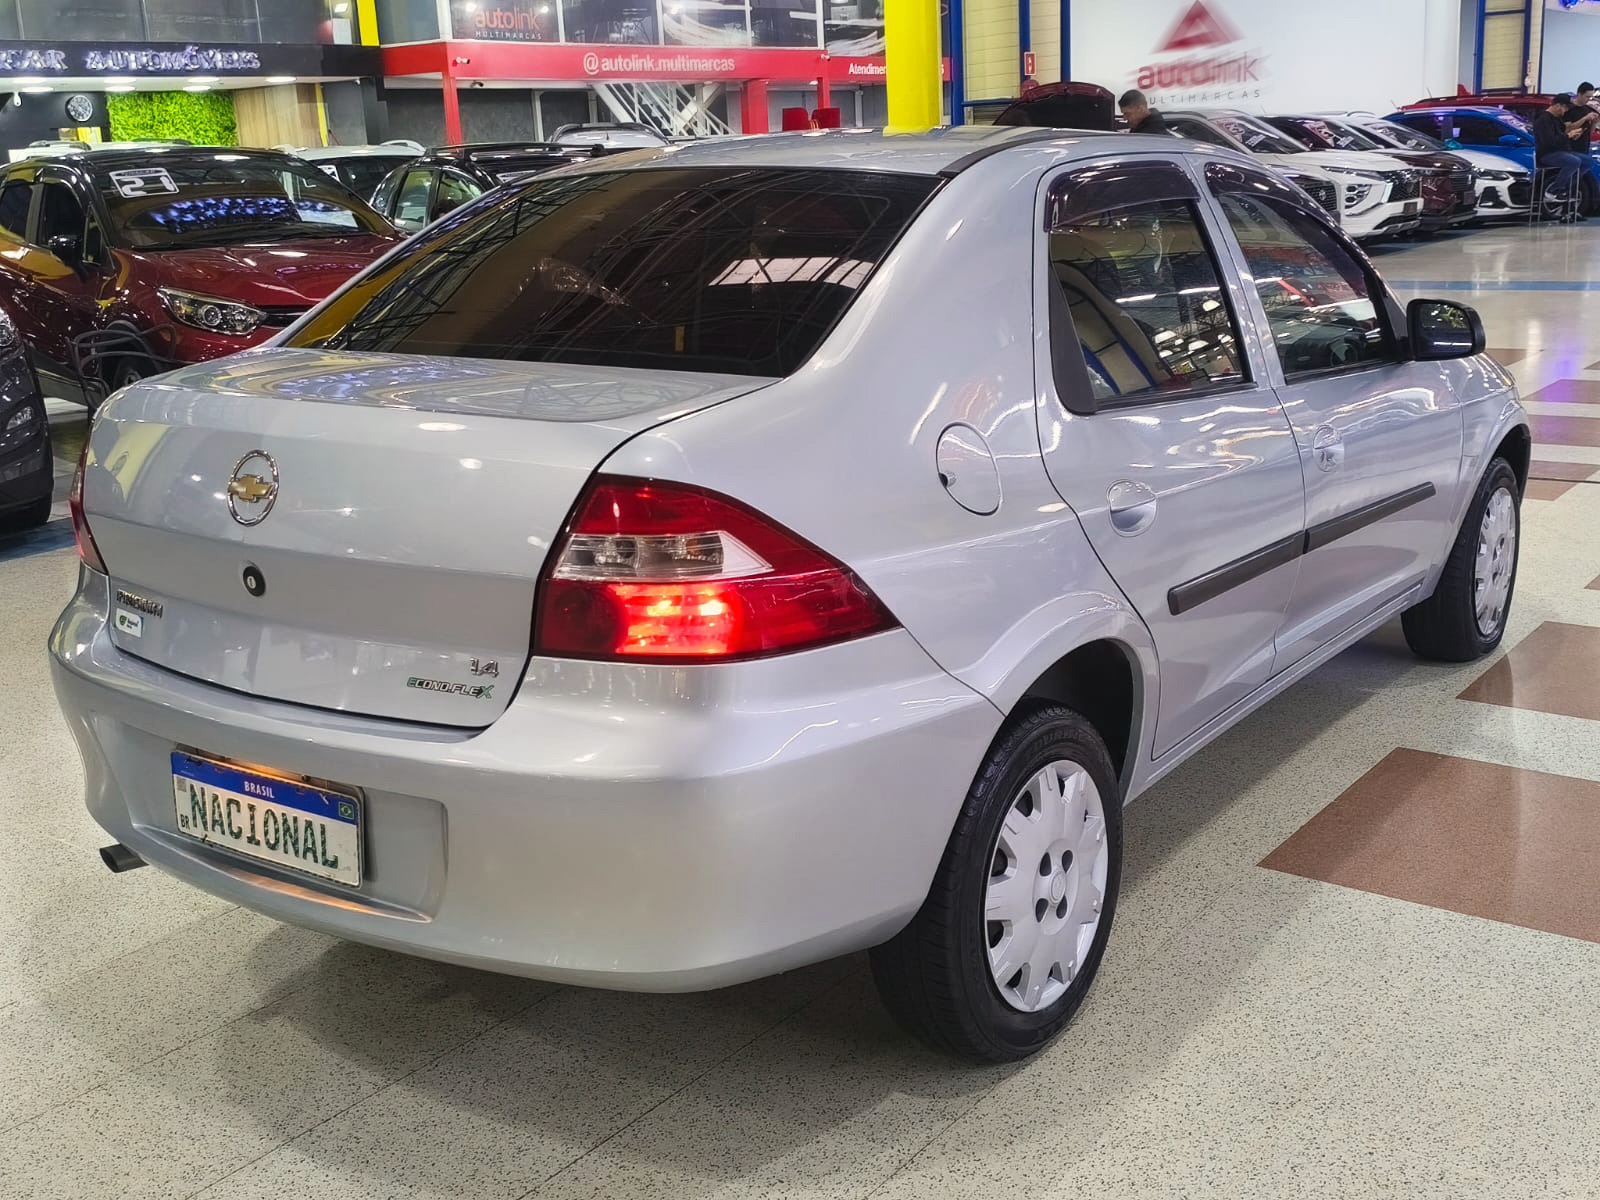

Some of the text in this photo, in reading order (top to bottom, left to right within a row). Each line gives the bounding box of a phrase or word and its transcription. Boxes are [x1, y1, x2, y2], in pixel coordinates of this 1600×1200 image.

[475, 7, 540, 30] autolink
[475, 31, 542, 40] MULTIMARCAS
[1149, 89, 1261, 105] ULTIMARCAS
[243, 781, 275, 799] BRASIL
[180, 813, 190, 830] BR
[189, 783, 339, 870] NACIONAL
